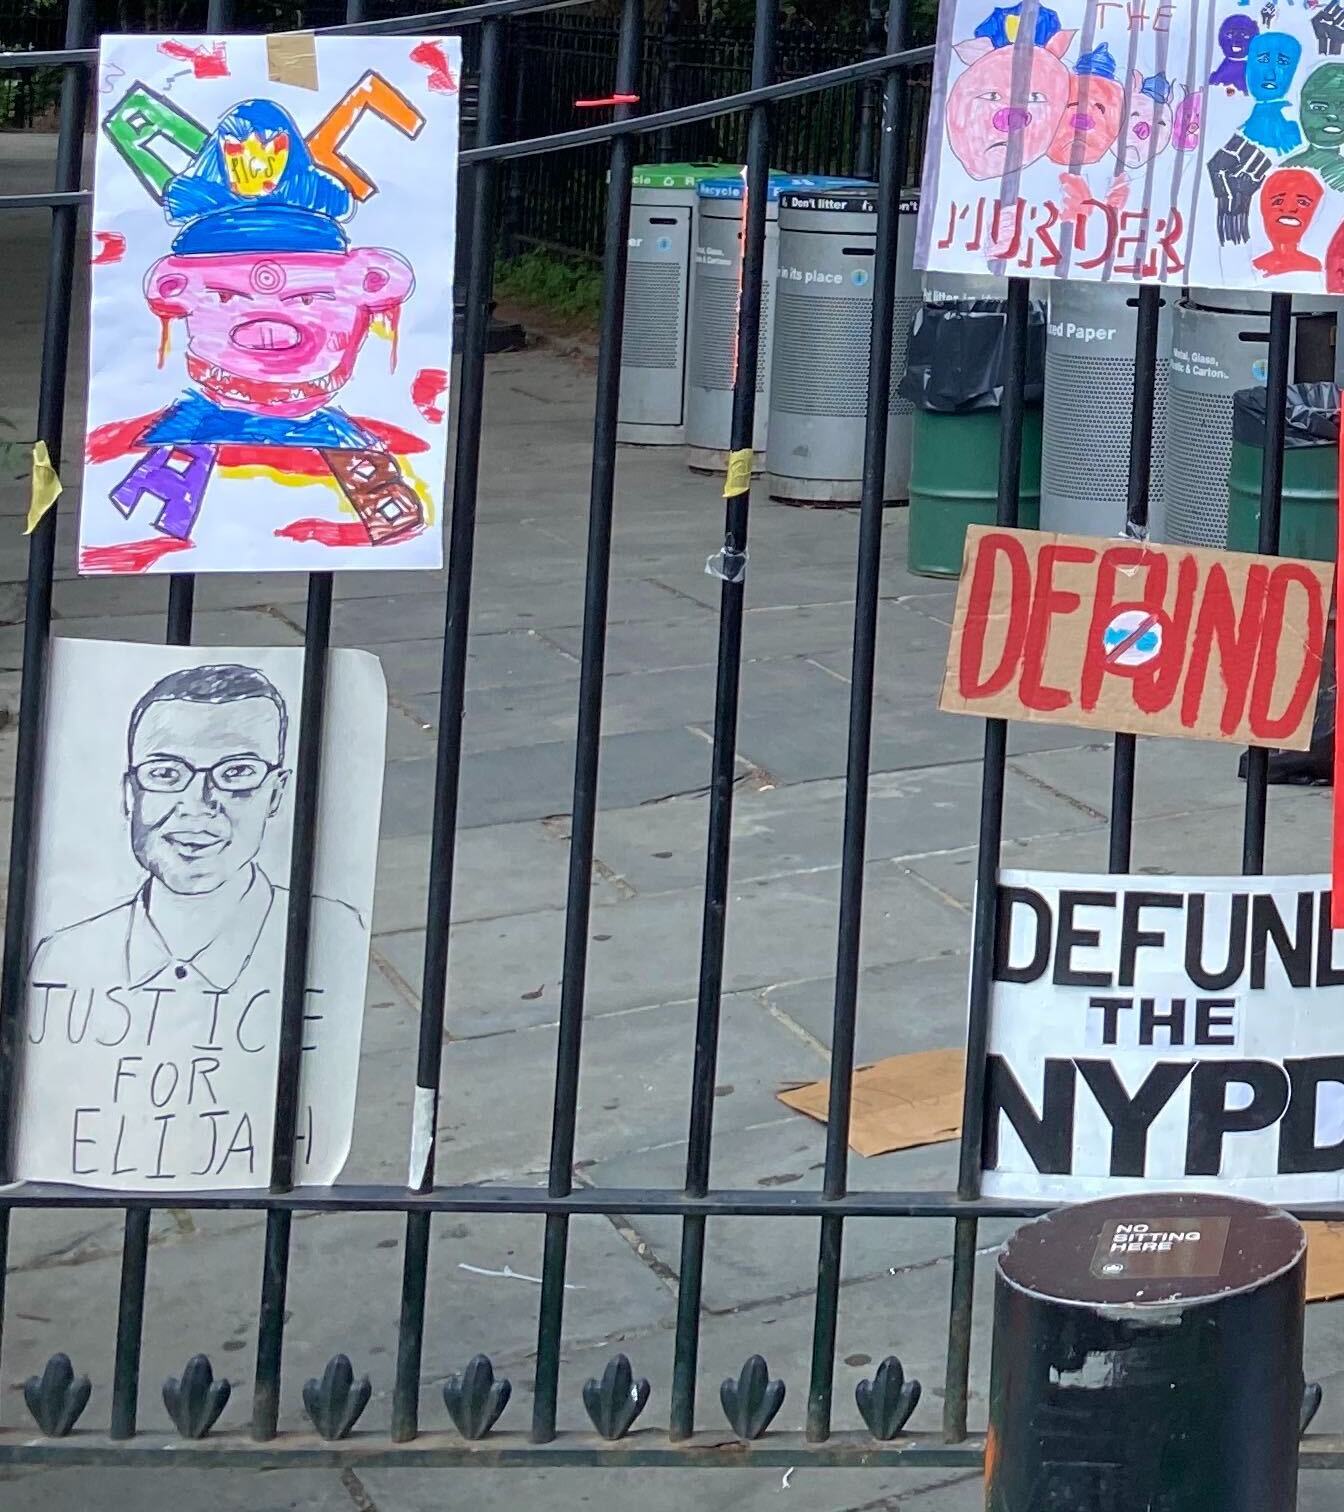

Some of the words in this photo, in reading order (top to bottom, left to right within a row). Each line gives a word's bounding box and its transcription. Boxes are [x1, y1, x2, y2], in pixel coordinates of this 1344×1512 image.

[1096, 0, 1177, 32] THE
[231, 155, 276, 185] PIGS
[818, 199, 847, 211] litter
[938, 197, 1185, 277] MURDER
[805, 270, 843, 285] place
[1066, 322, 1117, 343] Paper
[958, 534, 1326, 739] DEFUND
[1090, 997, 1237, 1046] THE
[113, 1055, 220, 1108] FOR
[1112, 1231, 1201, 1243] SITTING
[1115, 1223, 1149, 1234] NO
[1109, 1241, 1173, 1253] HERE
